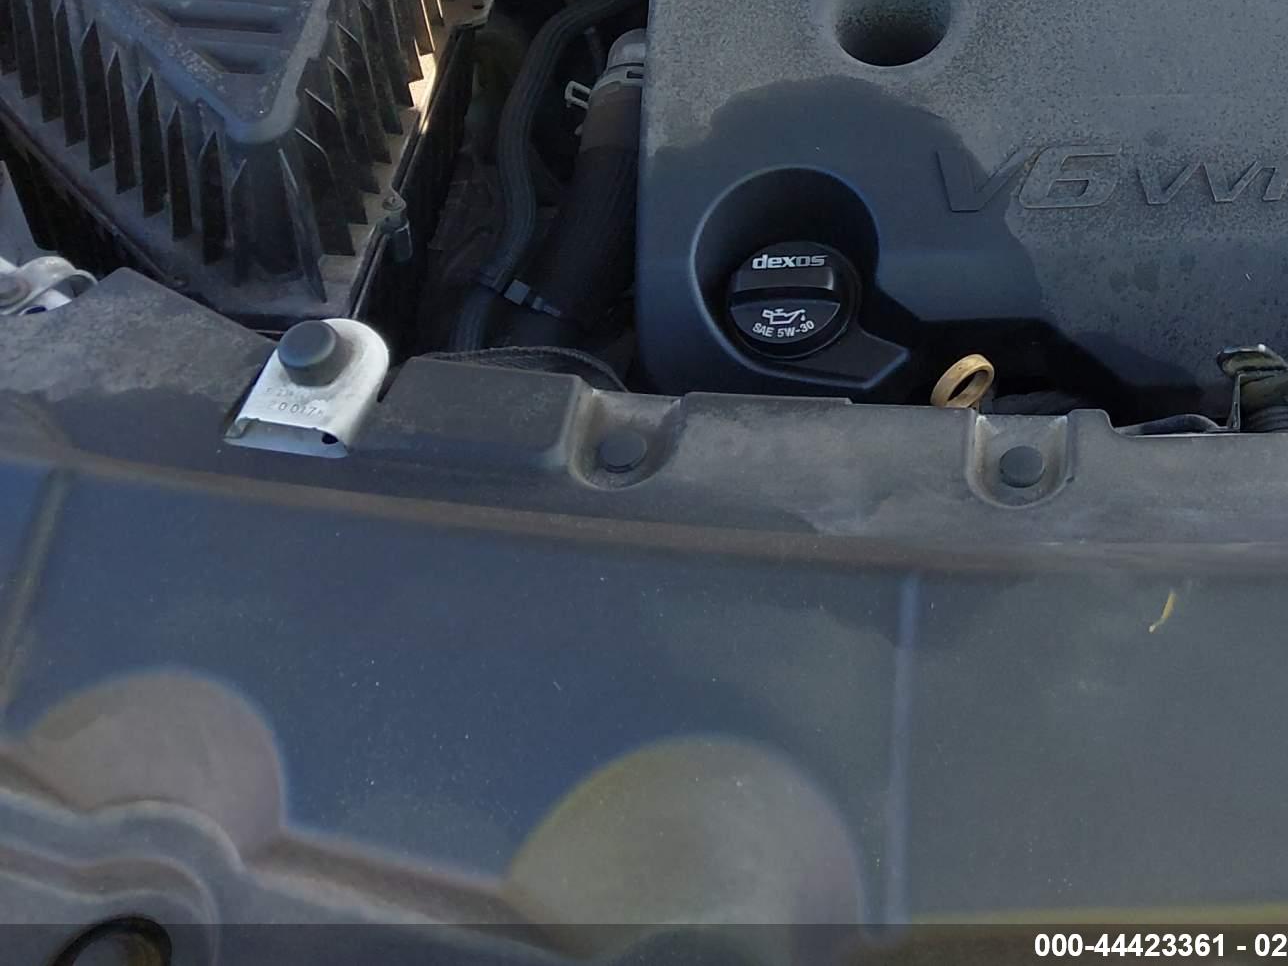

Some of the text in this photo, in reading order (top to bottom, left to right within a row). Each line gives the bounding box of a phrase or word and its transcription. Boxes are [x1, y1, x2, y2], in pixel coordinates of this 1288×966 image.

[934, 143, 1122, 213] V6
[752, 254, 828, 269] dexos
[752, 320, 815, 338] SAE 5W-30
